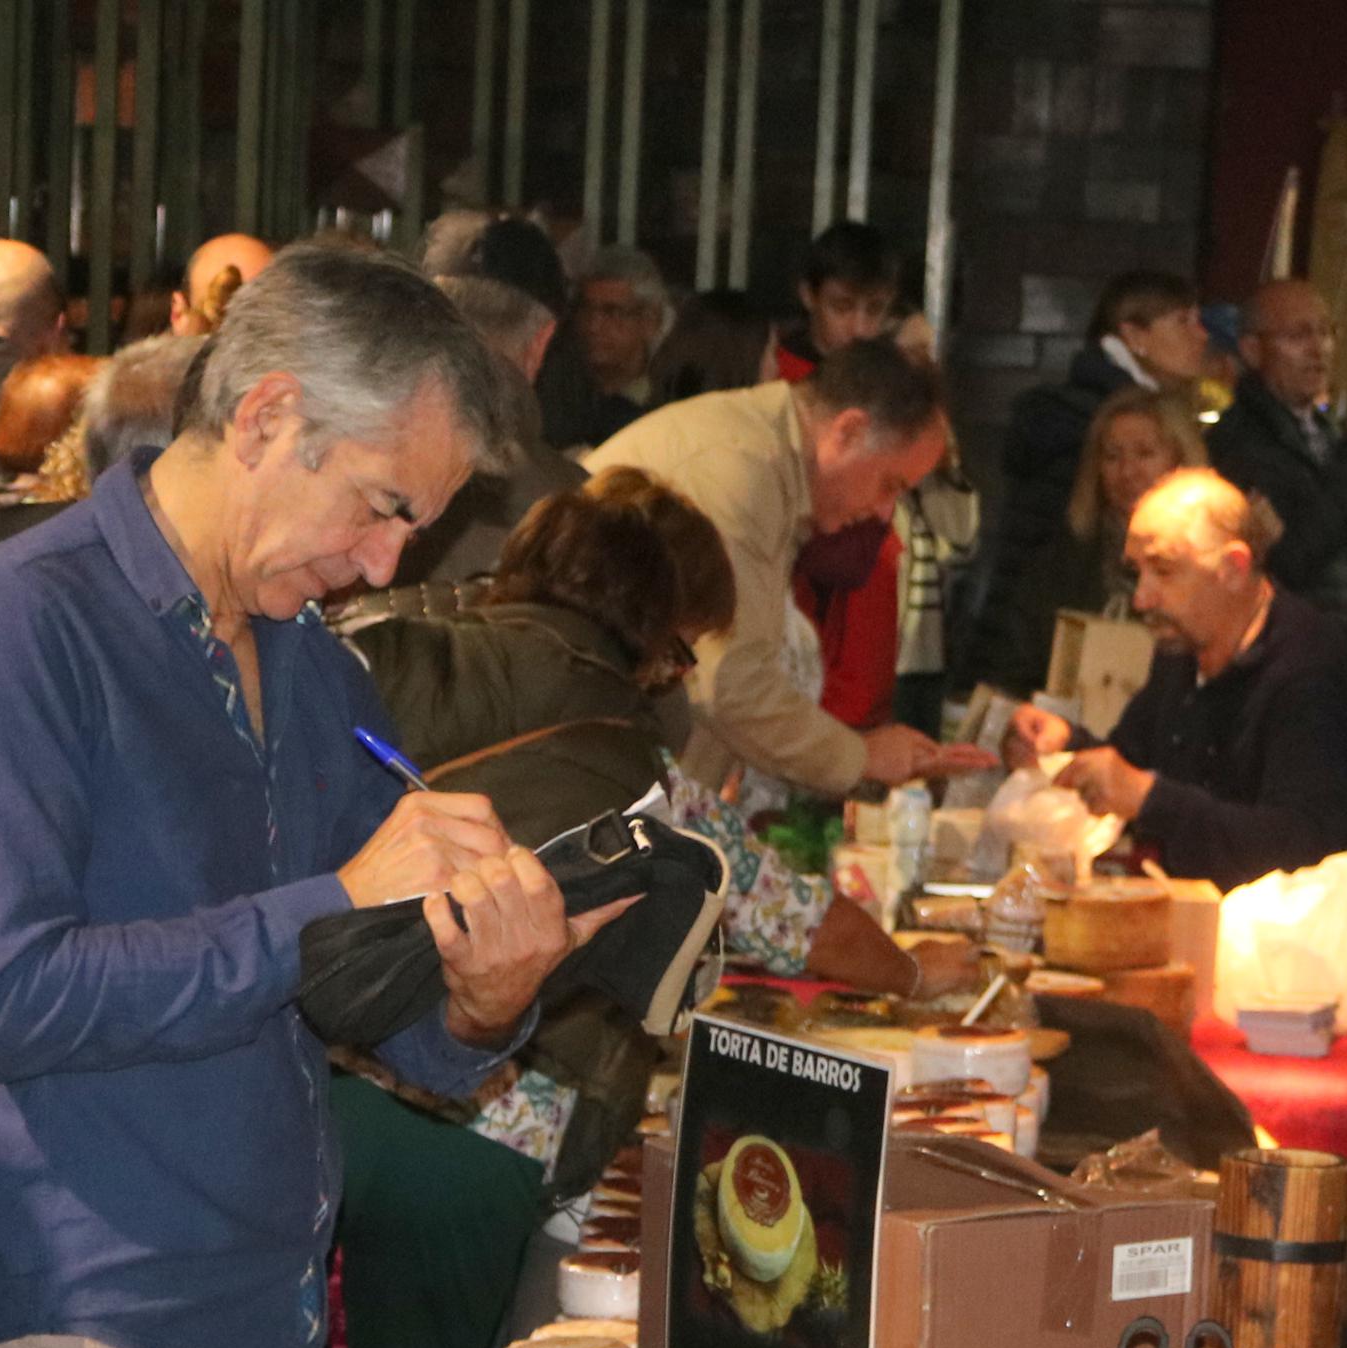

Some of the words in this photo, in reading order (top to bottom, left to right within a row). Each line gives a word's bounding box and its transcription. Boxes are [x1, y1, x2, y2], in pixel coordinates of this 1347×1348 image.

[709, 1027, 761, 1065] TORTA
[765, 1042, 788, 1073] DE
[791, 1050, 861, 1093] BARROS
[1127, 1243, 1180, 1257] SPAR
